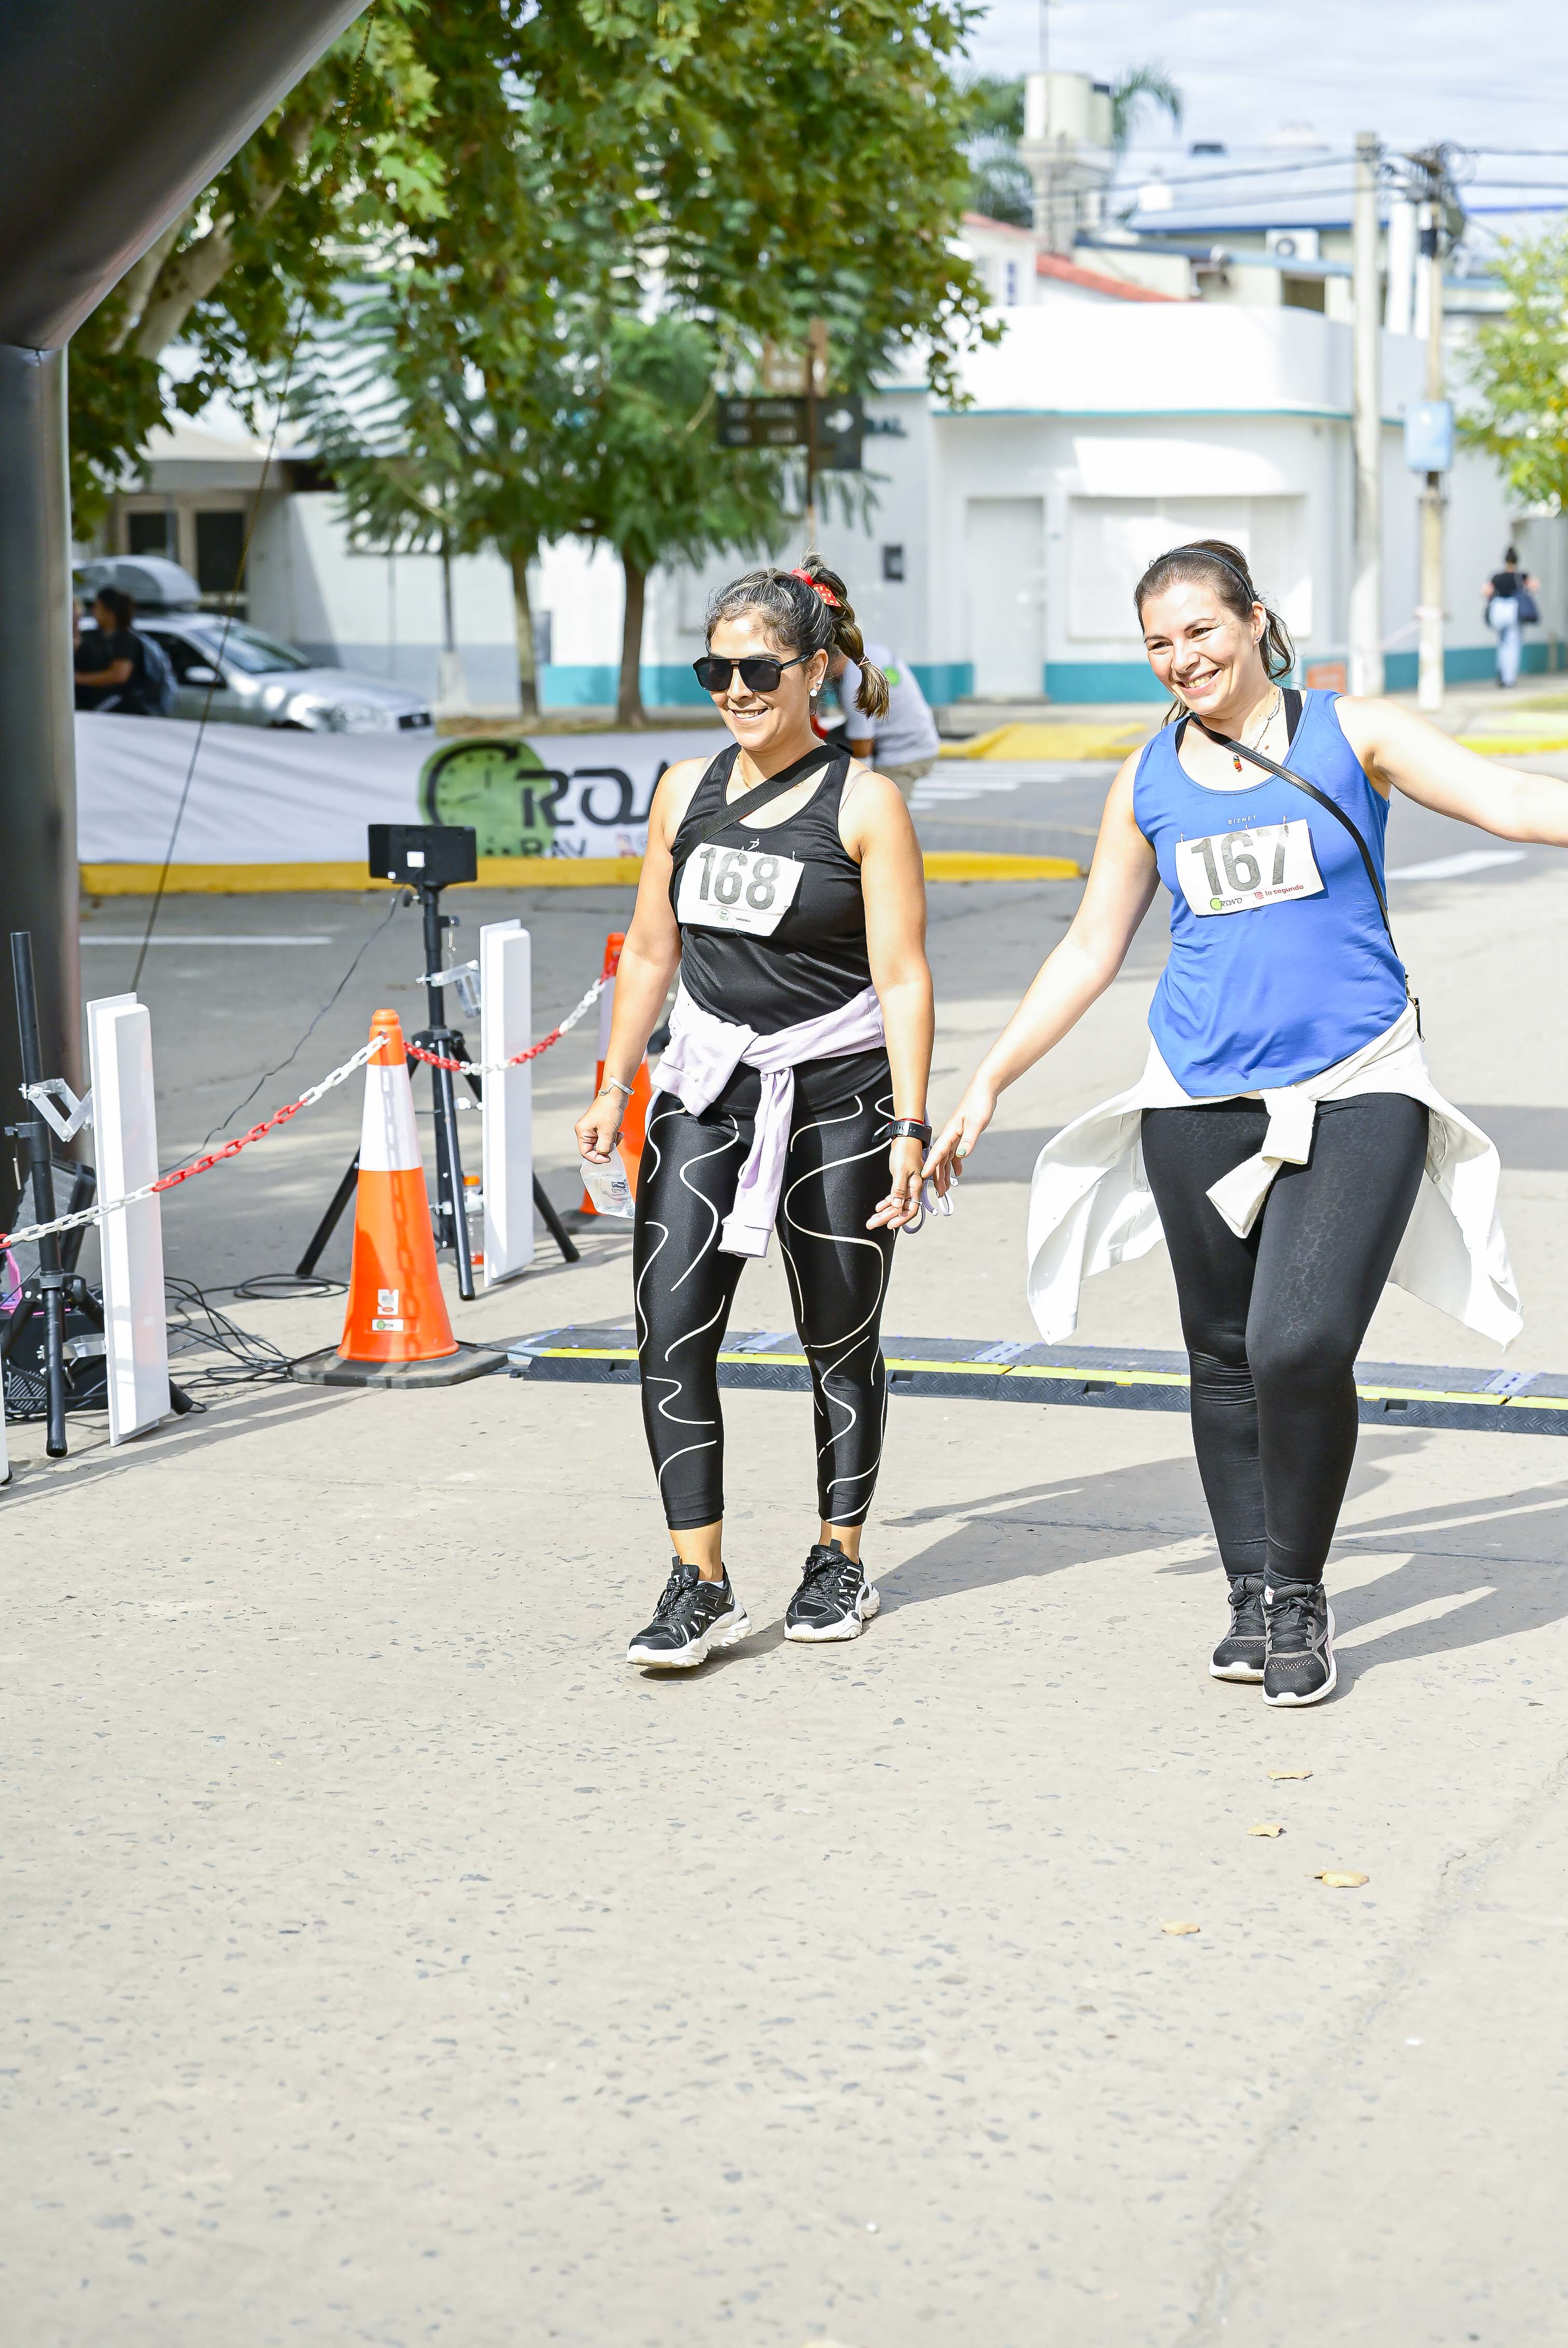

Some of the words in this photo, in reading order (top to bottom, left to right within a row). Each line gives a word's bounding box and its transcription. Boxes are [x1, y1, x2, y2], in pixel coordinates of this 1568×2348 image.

[1227, 815, 1257, 825] BIZNET
[699, 847, 779, 910] 168
[1191, 826, 1289, 895] 167
[1273, 884, 1304, 894] segunda
